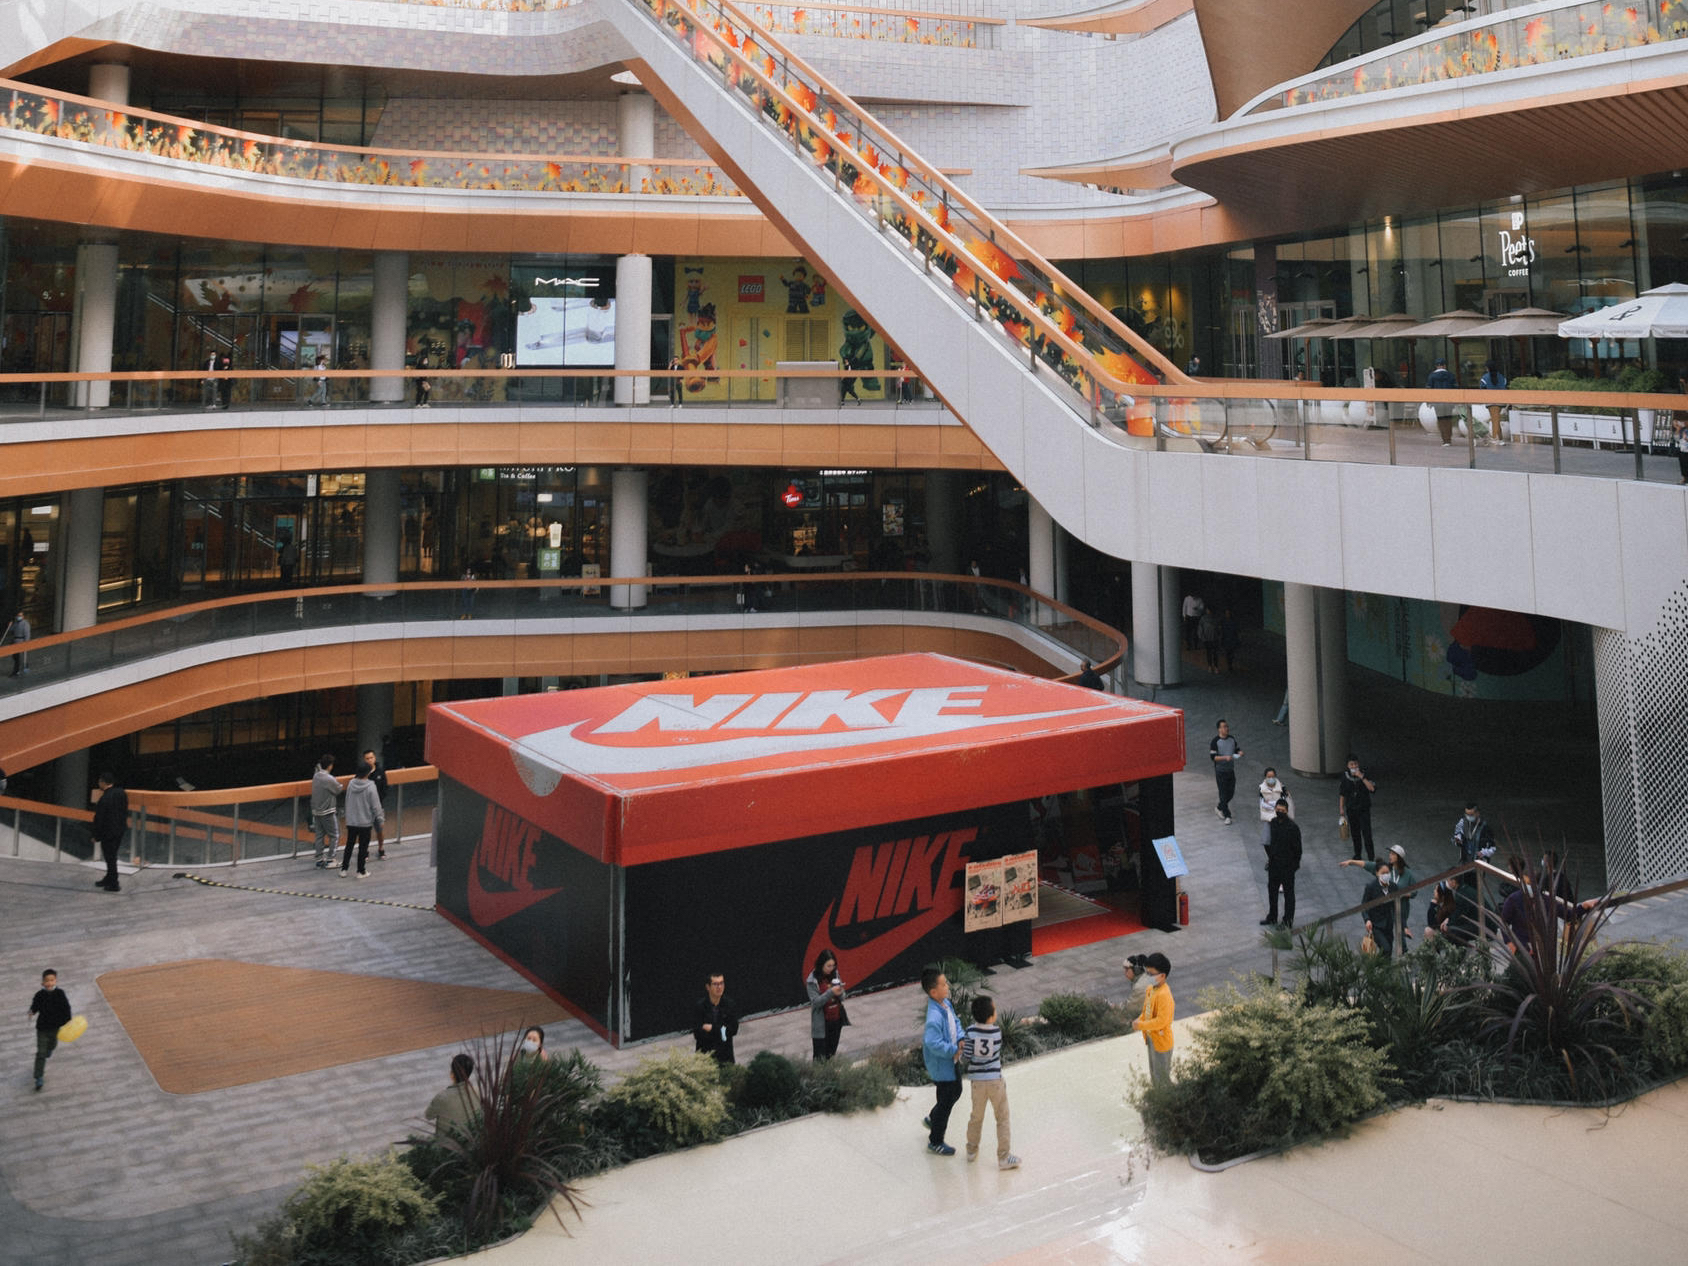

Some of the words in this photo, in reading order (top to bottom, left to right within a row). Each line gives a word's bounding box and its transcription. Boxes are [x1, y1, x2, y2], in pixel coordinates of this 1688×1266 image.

[1498, 231, 1535, 266] Peet's
[1508, 268, 1529, 277] COFFEE
[741, 283, 762, 294] LEGO
[784, 493, 800, 504] Tims
[591, 685, 989, 733] NIKE
[479, 802, 543, 891] NIKE
[834, 826, 979, 928] NIKE
[979, 1038, 991, 1057] 3
